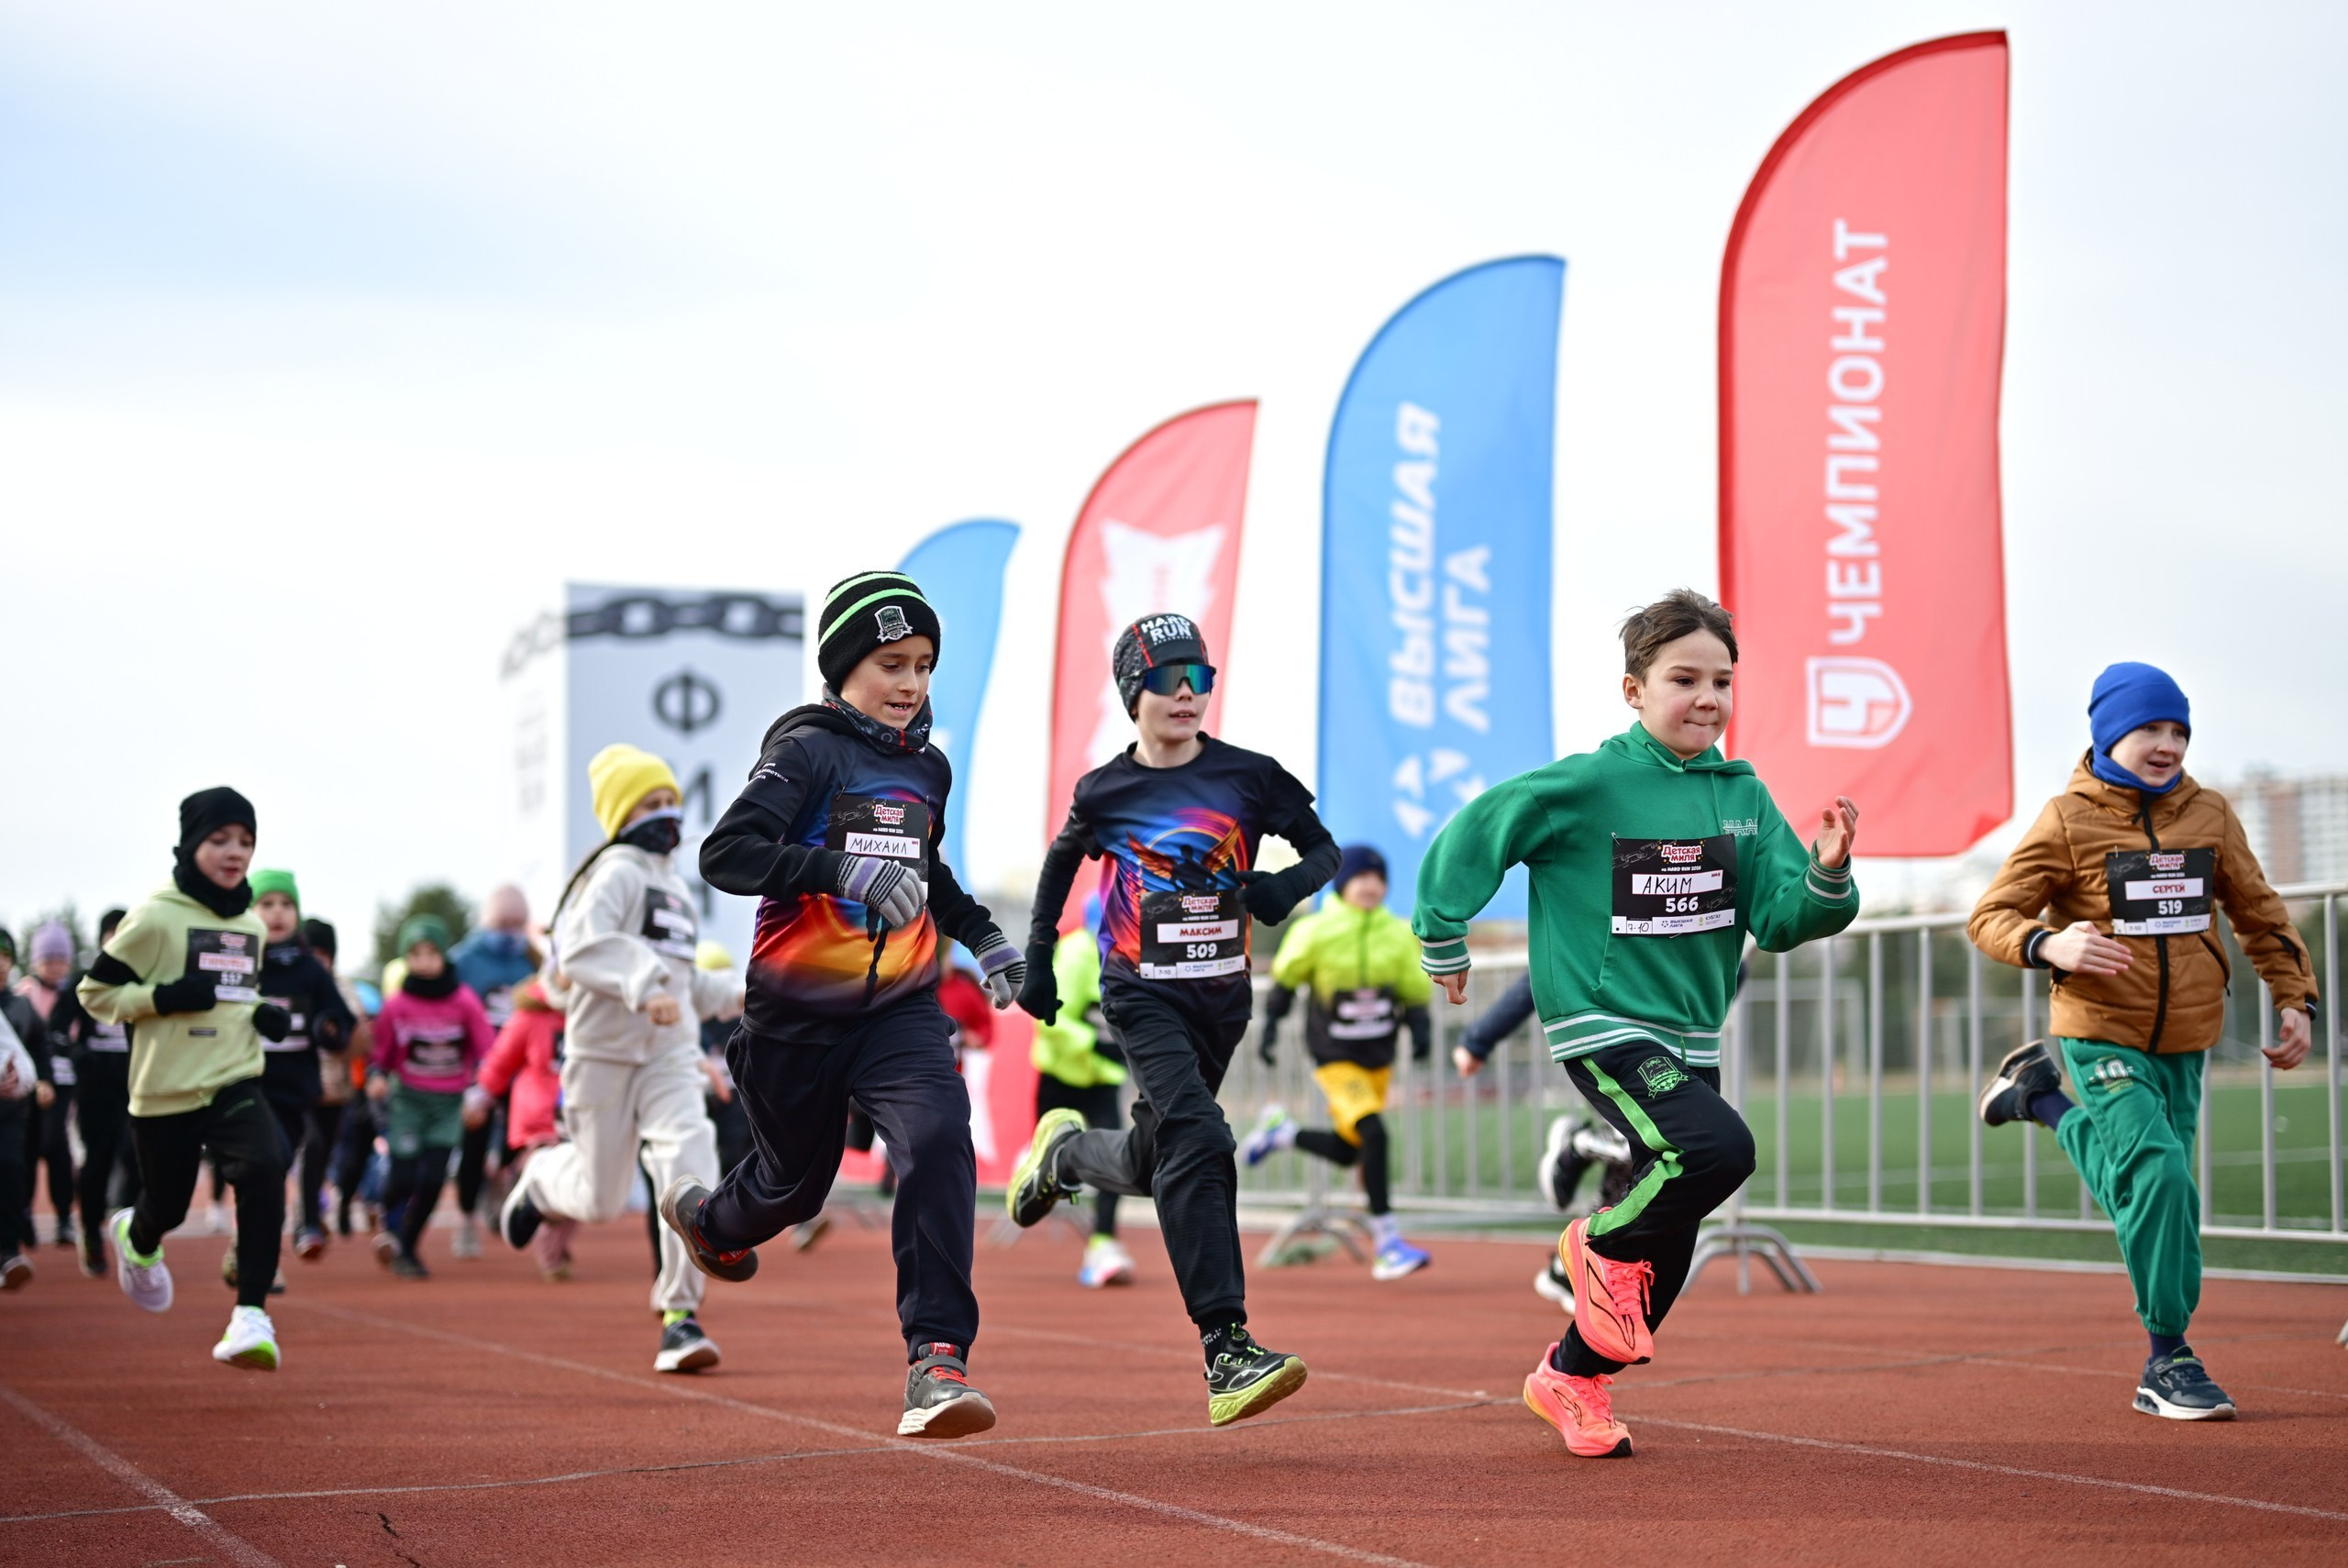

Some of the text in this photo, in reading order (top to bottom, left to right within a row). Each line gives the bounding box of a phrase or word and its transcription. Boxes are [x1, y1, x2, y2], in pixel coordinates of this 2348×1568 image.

[1824, 217, 1888, 646] ЧЕМПИОНАТ
[1389, 401, 1441, 729] ВЫСШАЯ
[1141, 615, 1191, 634] HARD
[1150, 624, 1192, 642] RUN
[1443, 543, 1492, 734] ЛИГА
[874, 805, 903, 817] Детская
[880, 815, 901, 823] миля
[850, 837, 907, 855] МИХАИЛ
[1663, 845, 1701, 856] Детская
[1643, 876, 1692, 894] АКИМ
[2153, 881, 2186, 894] СЕРГЕЙ
[1666, 897, 1699, 913] 566
[2158, 900, 2183, 914] 519
[1180, 926, 1223, 936] МАКСИМ
[1628, 922, 1649, 933] 7-10
[1186, 943, 1218, 958] 509
